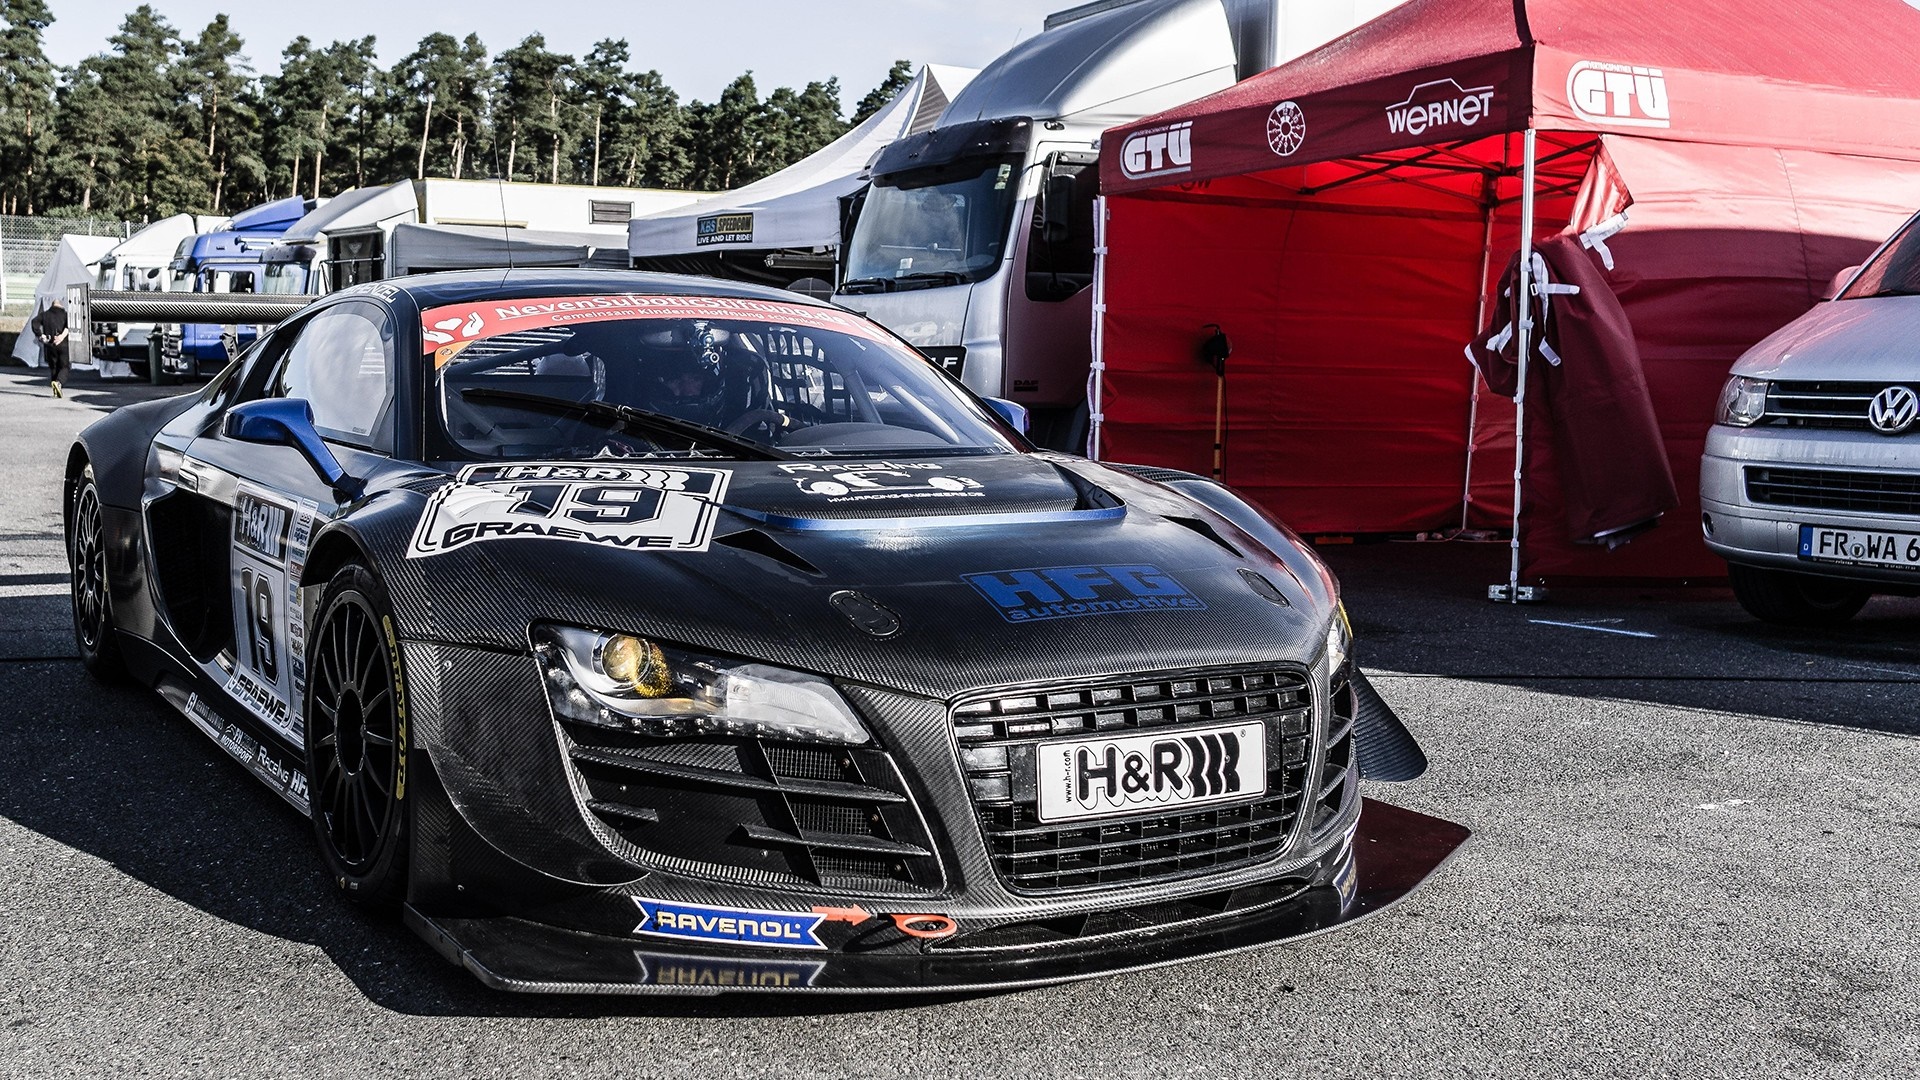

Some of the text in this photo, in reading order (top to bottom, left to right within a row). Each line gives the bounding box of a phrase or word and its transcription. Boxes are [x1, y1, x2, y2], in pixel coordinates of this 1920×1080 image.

[1573, 66, 1670, 119] GTÜ
[1124, 120, 1193, 173] GTÜ
[710, 235, 725, 243] AND
[725, 234, 735, 242] LET
[736, 233, 752, 241] RIDE!
[551, 307, 825, 327] Gemeinsam Kindern Hoffnung schenken
[505, 466, 622, 481] H&R
[442, 521, 674, 549] GRAEWE
[1819, 531, 1848, 556] FR
[1867, 534, 1897, 560] WA
[1906, 537, 1920, 562] 6
[969, 565, 1188, 608] HFG
[1008, 597, 1200, 620] automotive
[241, 566, 279, 686] 19
[237, 674, 287, 724] GRAEWE
[220, 734, 253, 764] MOTORSPORT
[1063, 749, 1072, 804] www.h-r.com
[1077, 741, 1184, 801] H&R
[657, 911, 801, 938] RAVENOL
